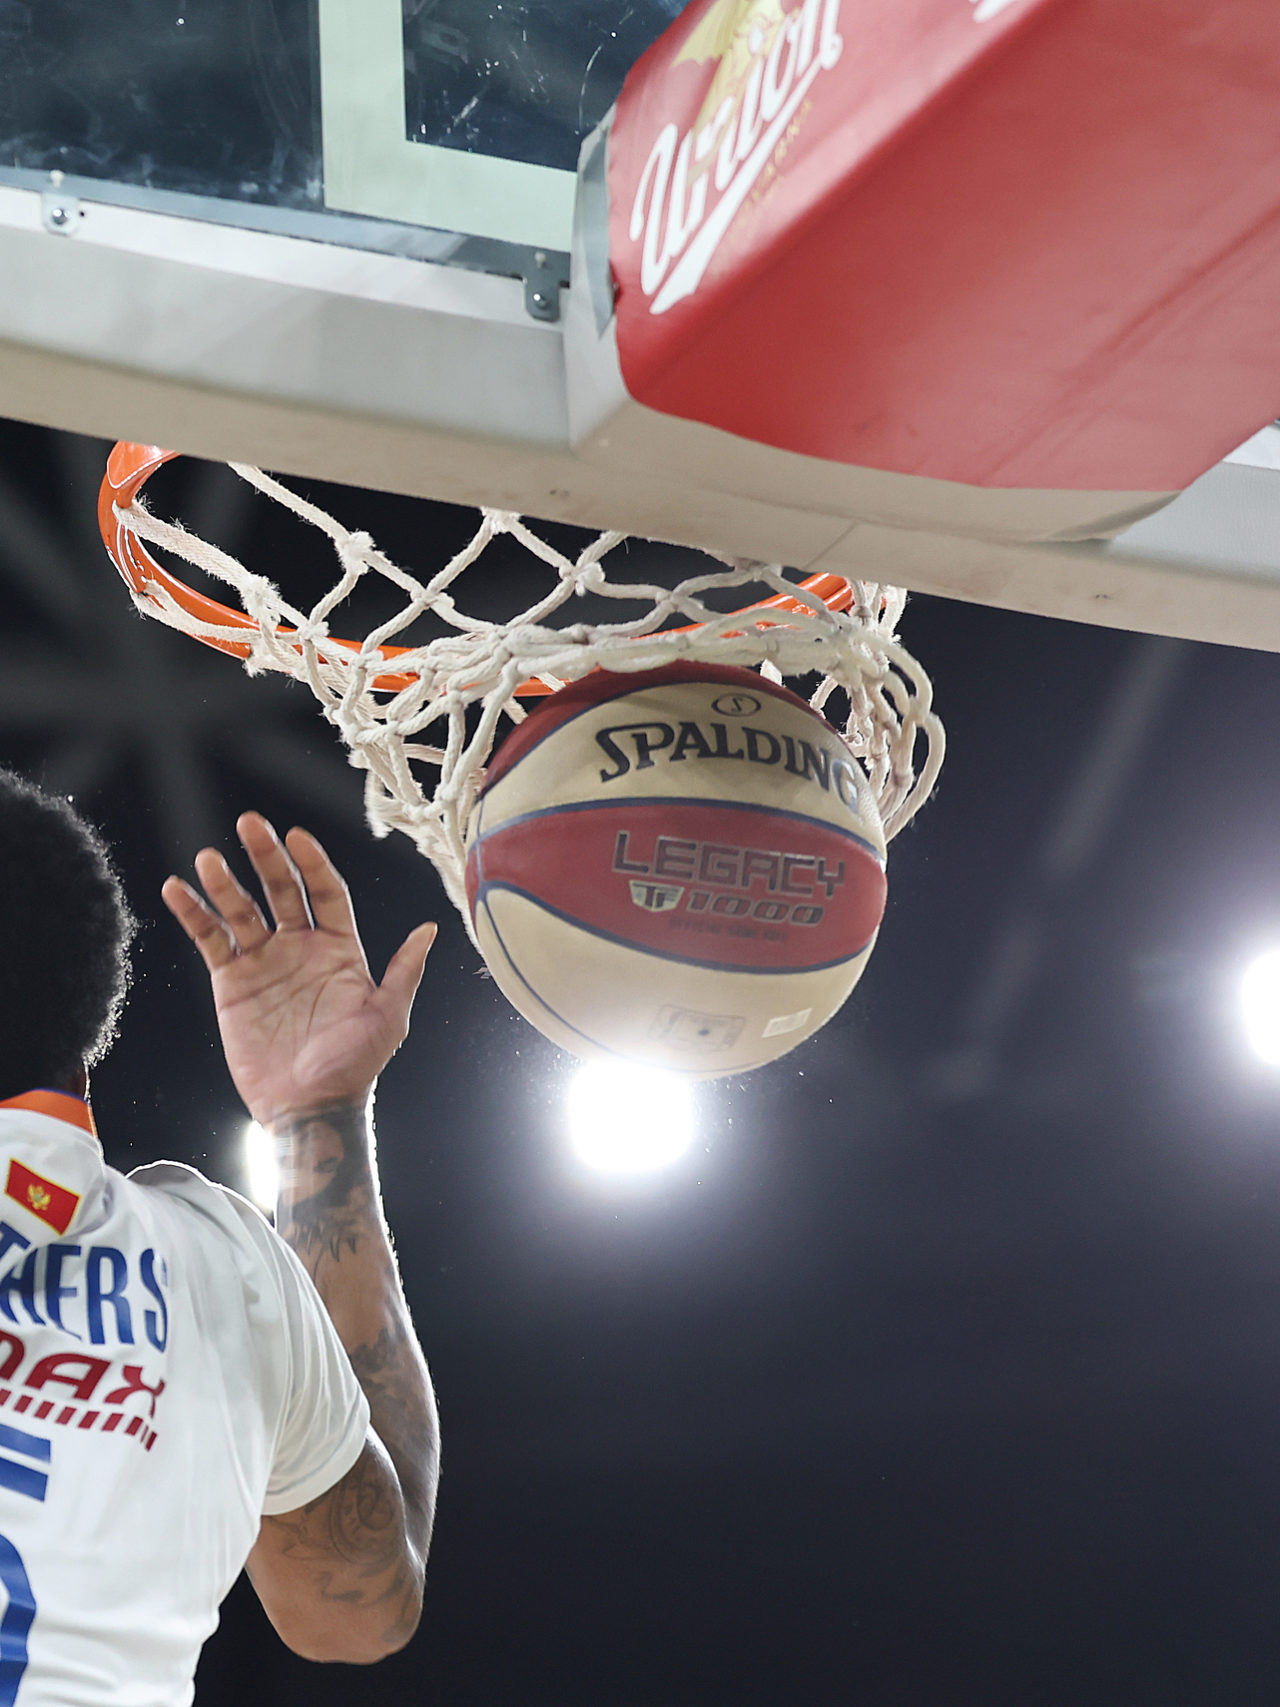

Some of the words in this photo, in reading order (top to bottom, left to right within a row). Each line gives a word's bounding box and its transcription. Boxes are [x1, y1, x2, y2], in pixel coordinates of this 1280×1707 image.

[595, 721, 860, 816] SPALDING
[612, 831, 845, 898] LEGACY
[686, 889, 825, 927] 1000
